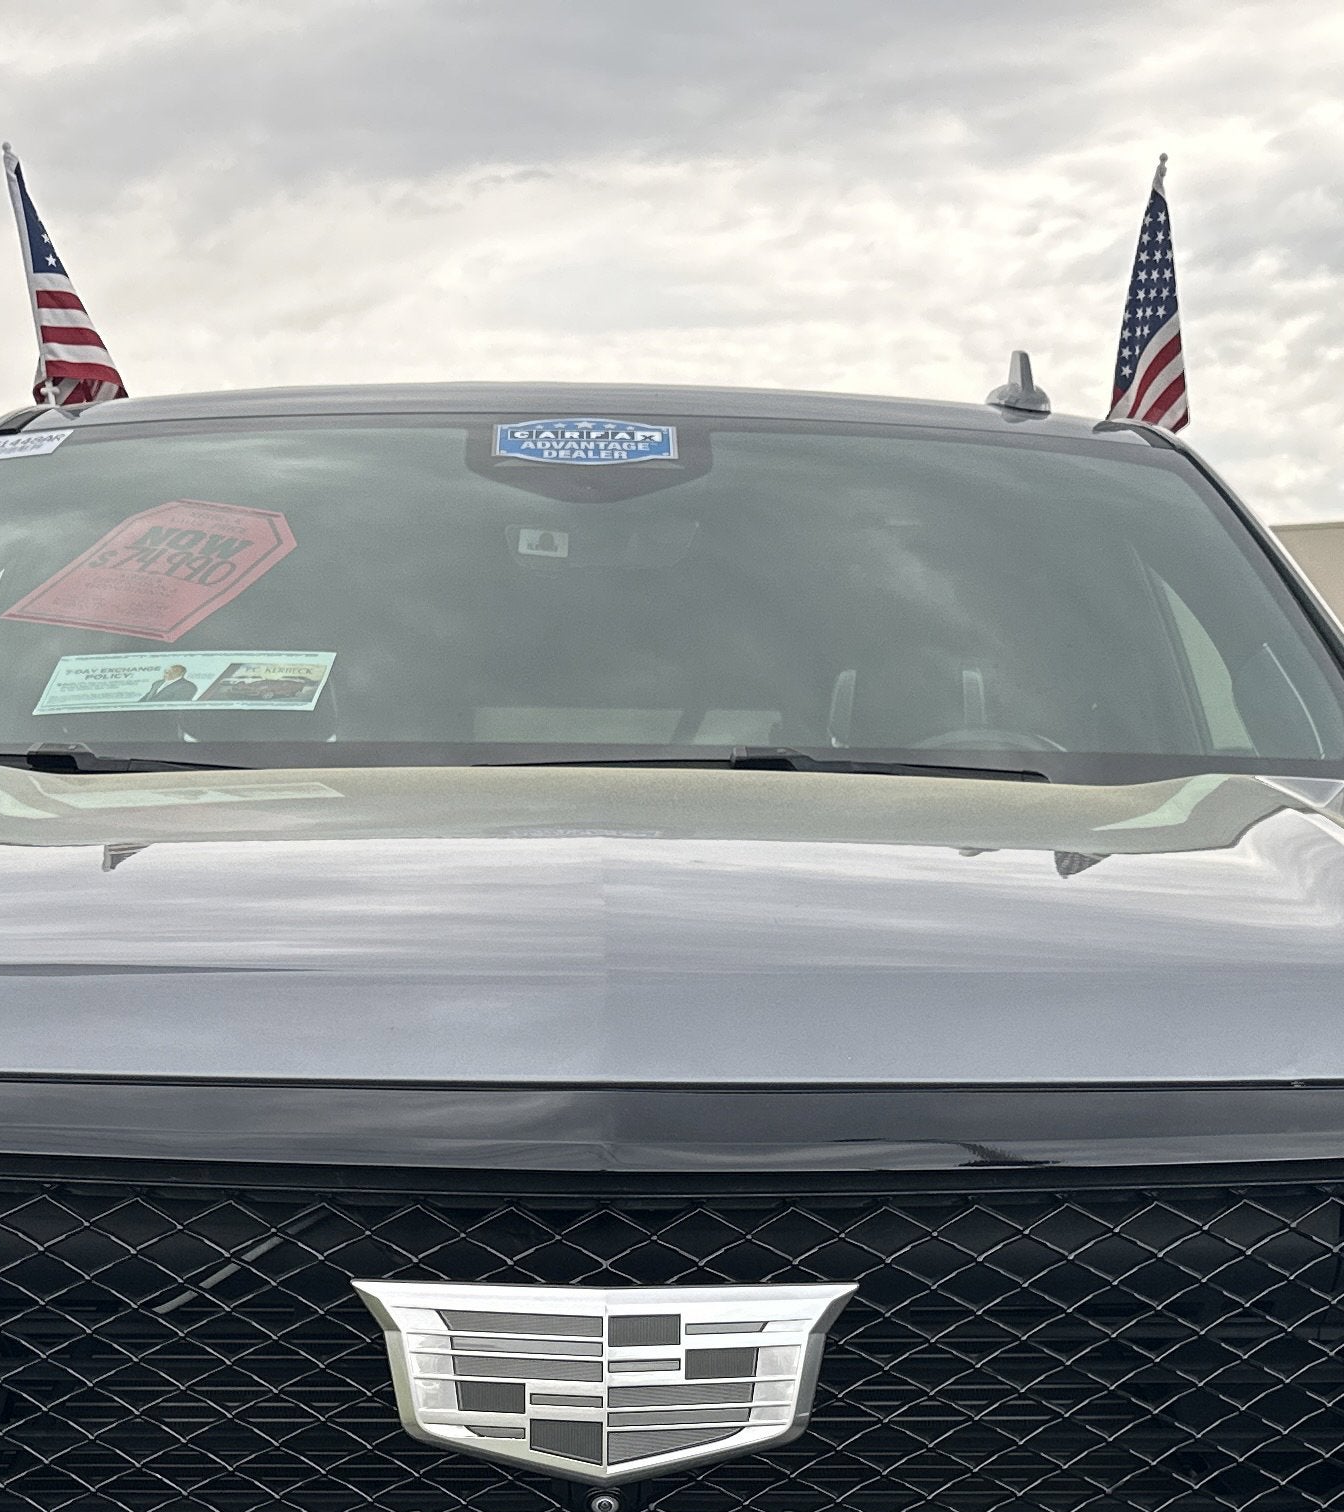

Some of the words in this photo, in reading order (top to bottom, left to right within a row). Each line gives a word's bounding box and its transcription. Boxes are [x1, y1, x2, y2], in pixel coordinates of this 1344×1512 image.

[510, 430, 661, 442] CARFAX
[520, 440, 651, 451] ADVANTAGE
[542, 449, 628, 460] DEALER
[133, 526, 255, 560] NOW
